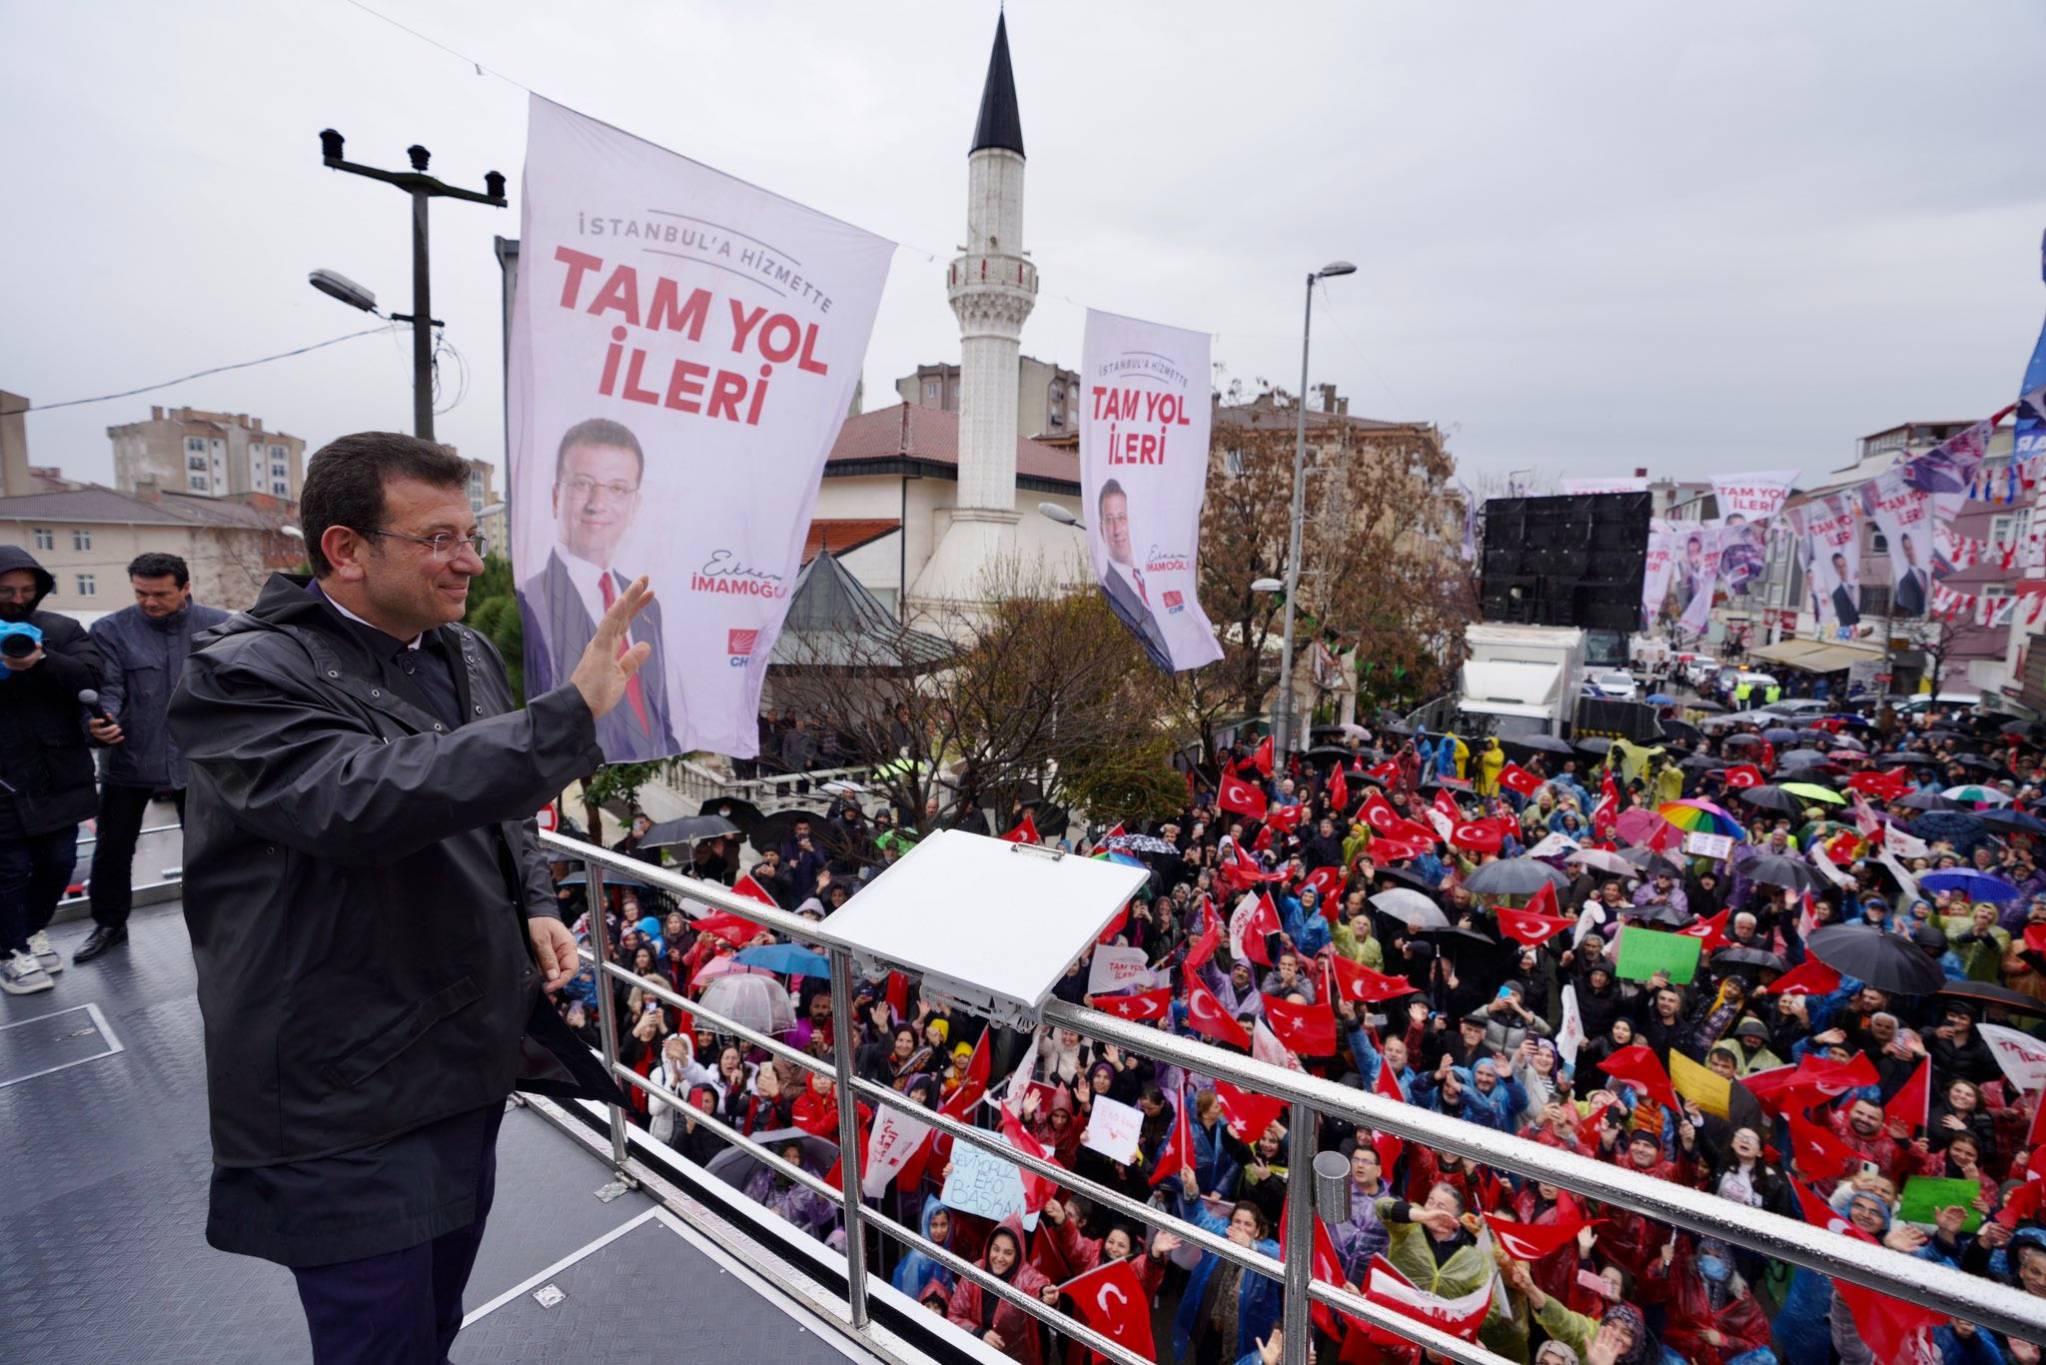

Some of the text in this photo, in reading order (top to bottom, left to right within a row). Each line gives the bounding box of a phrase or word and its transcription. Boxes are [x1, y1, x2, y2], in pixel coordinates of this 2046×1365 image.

[578, 212, 833, 314] İSTANBUL'A HİZMETTE
[553, 245, 829, 376] TAM YOL
[598, 325, 773, 426] İLERİ
[1092, 386, 1190, 425] TAM YOL
[1108, 423, 1167, 465] İLERİ
[1719, 487, 1787, 500] TAM YOL
[1734, 496, 1776, 512] İLERİ
[1146, 560, 1189, 572] İMAMOĞL
[691, 572, 788, 600] İMAMOĞU
[730, 656, 749, 667] CH
